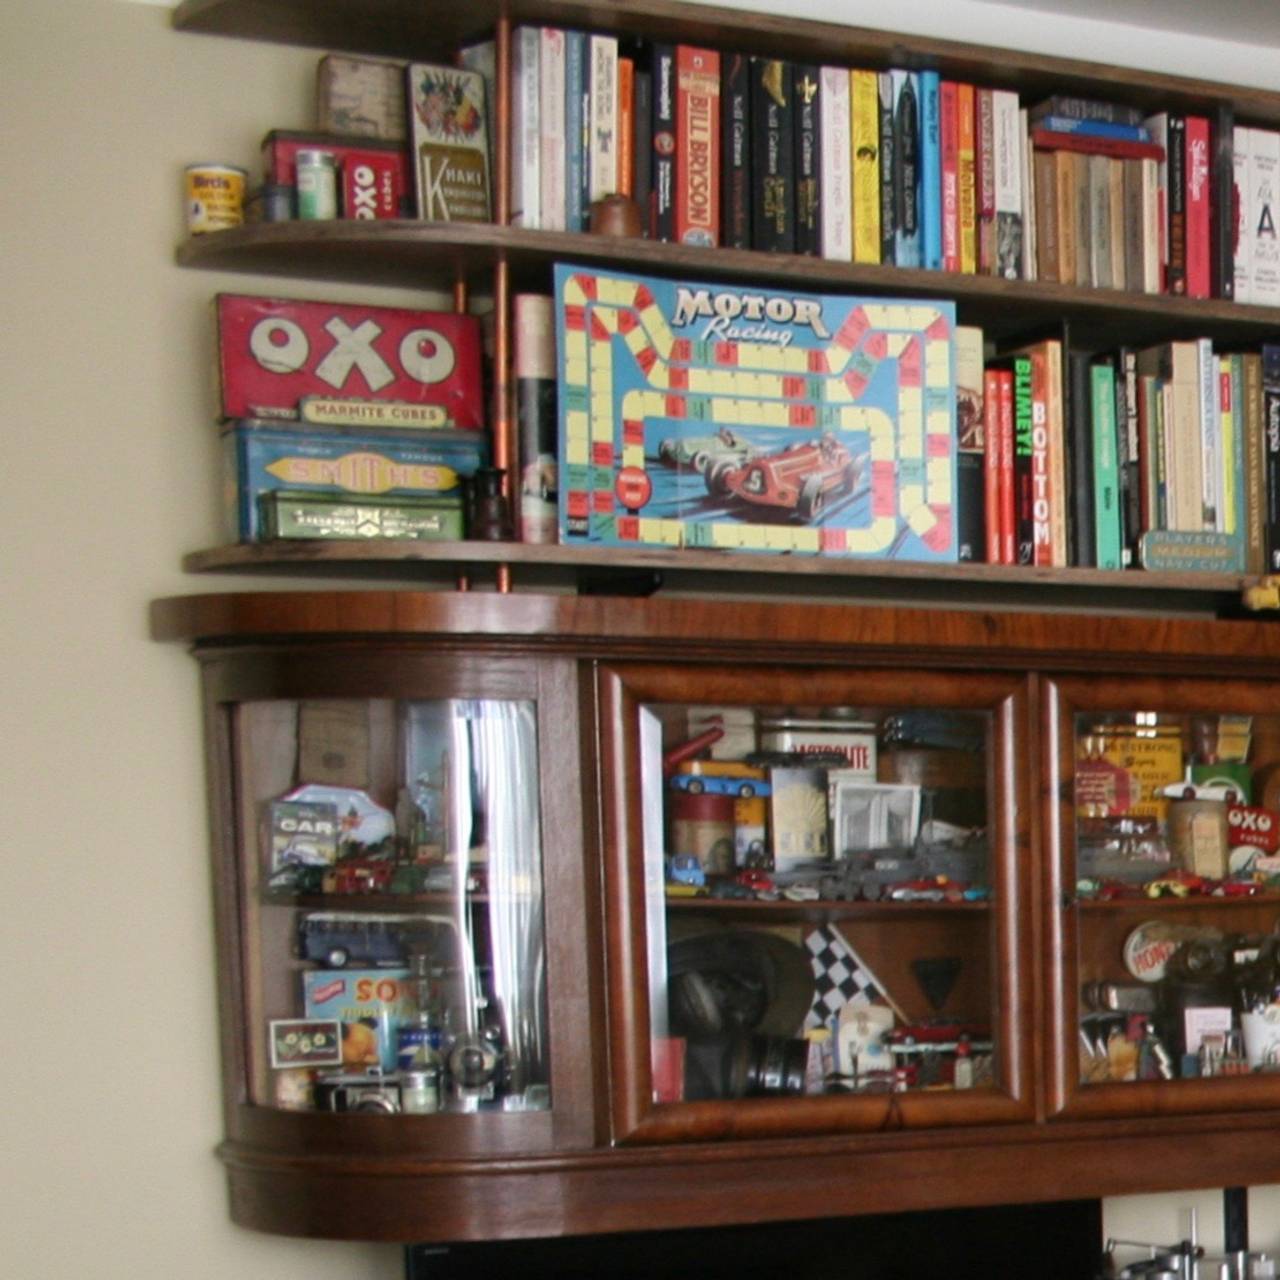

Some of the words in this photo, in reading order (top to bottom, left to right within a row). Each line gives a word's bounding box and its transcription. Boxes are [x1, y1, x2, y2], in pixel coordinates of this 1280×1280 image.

[690, 96, 708, 135] BILL
[690, 140, 709, 221] BRYSON
[673, 288, 832, 339] MOTOR
[701, 316, 794, 346] Racing
[250, 315, 456, 393] OXO
[314, 402, 385, 419] MARMITE
[391, 406, 438, 421] CUBES
[1015, 358, 1032, 456] BLIMEY!
[748, 471, 762, 491] 5
[1032, 402, 1050, 546] BOTTOM
[1228, 808, 1273, 832] OXO
